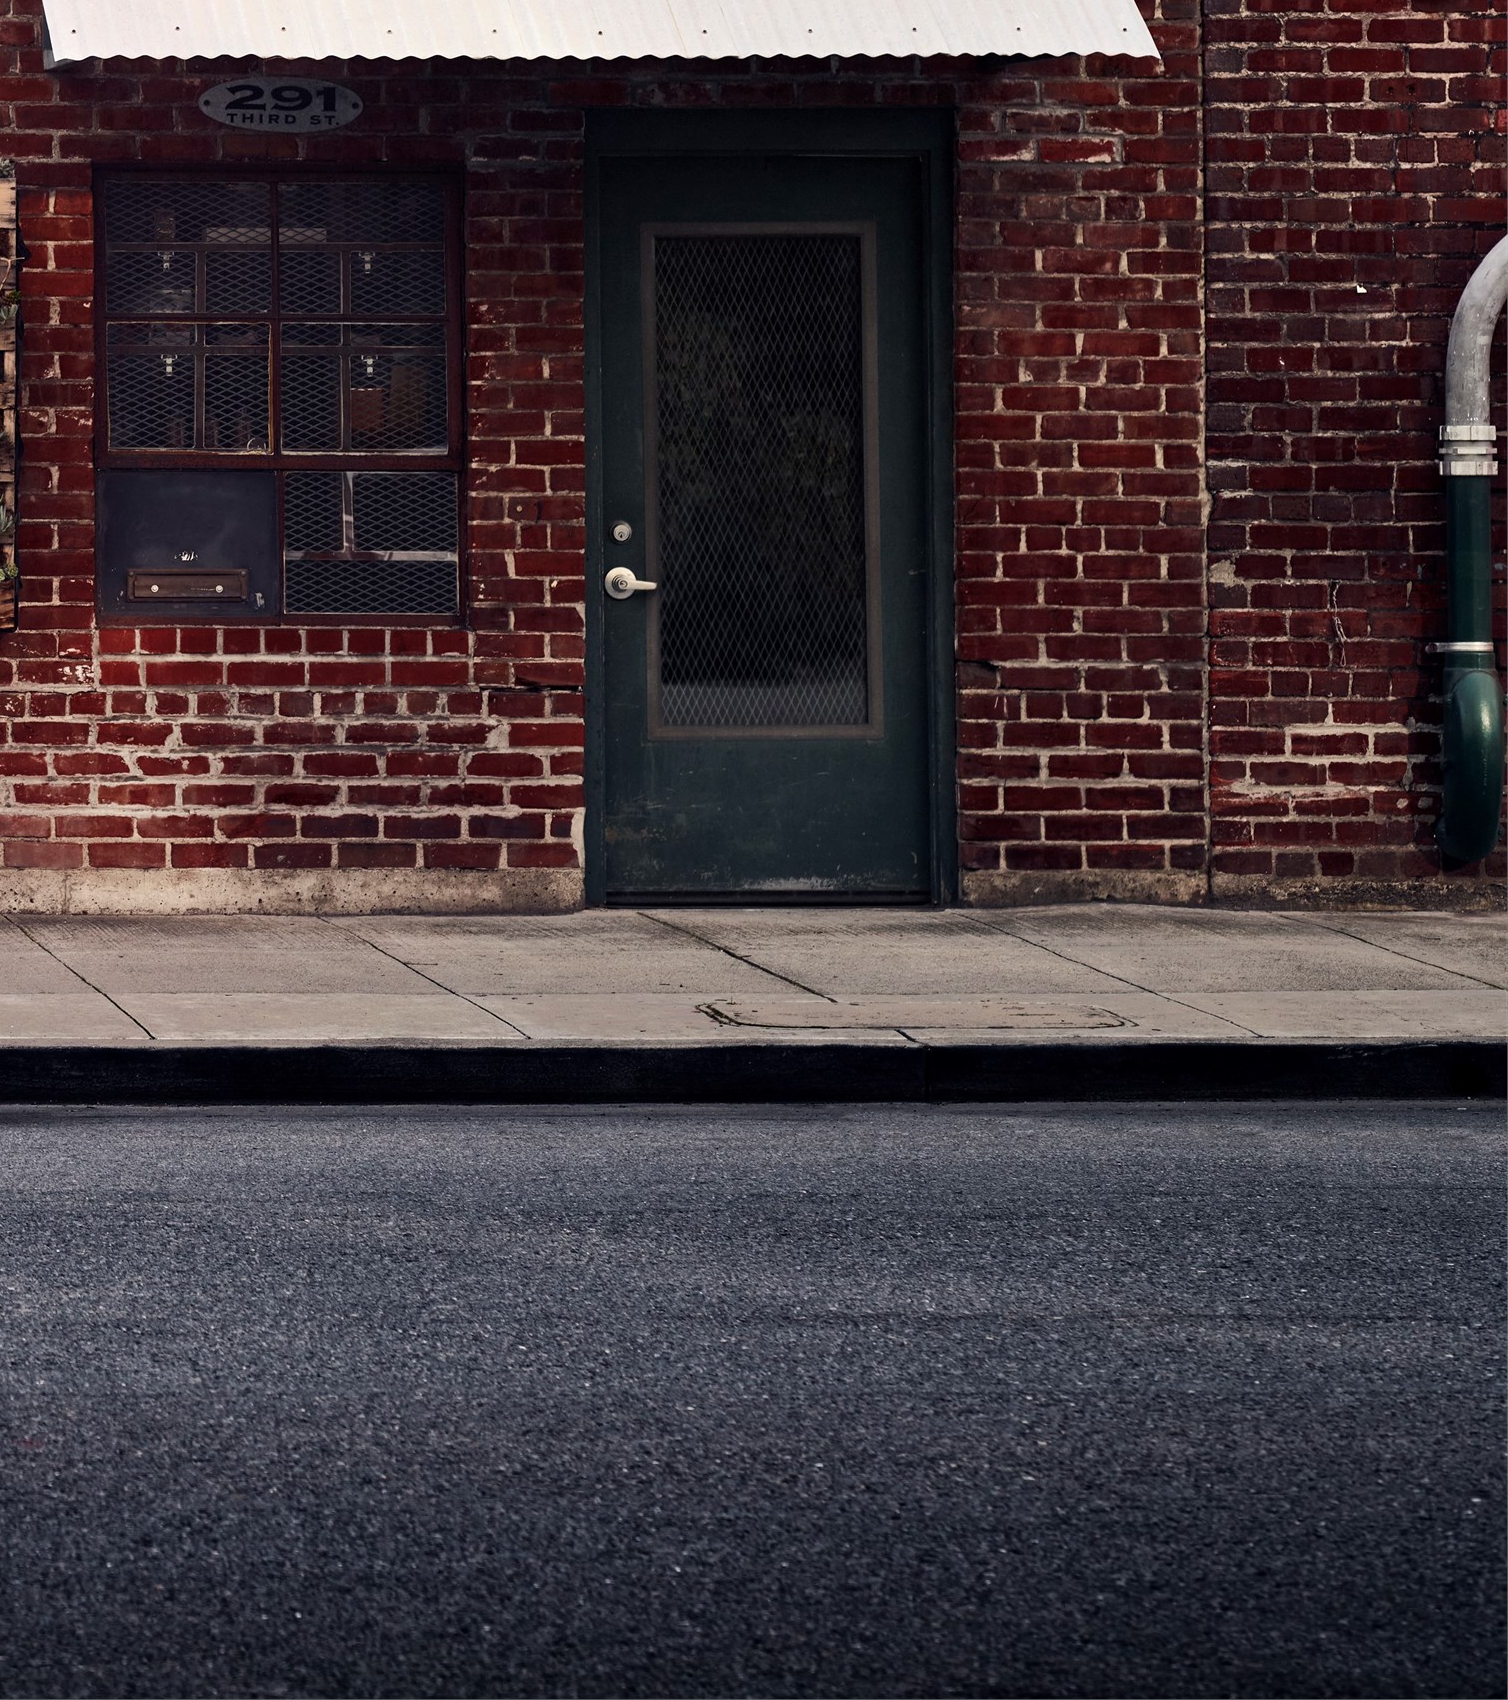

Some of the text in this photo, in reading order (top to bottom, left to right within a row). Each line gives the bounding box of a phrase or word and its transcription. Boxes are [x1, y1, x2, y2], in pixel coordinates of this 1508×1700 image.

[224, 84, 337, 113] 291
[226, 112, 340, 126] THIRD ST.
